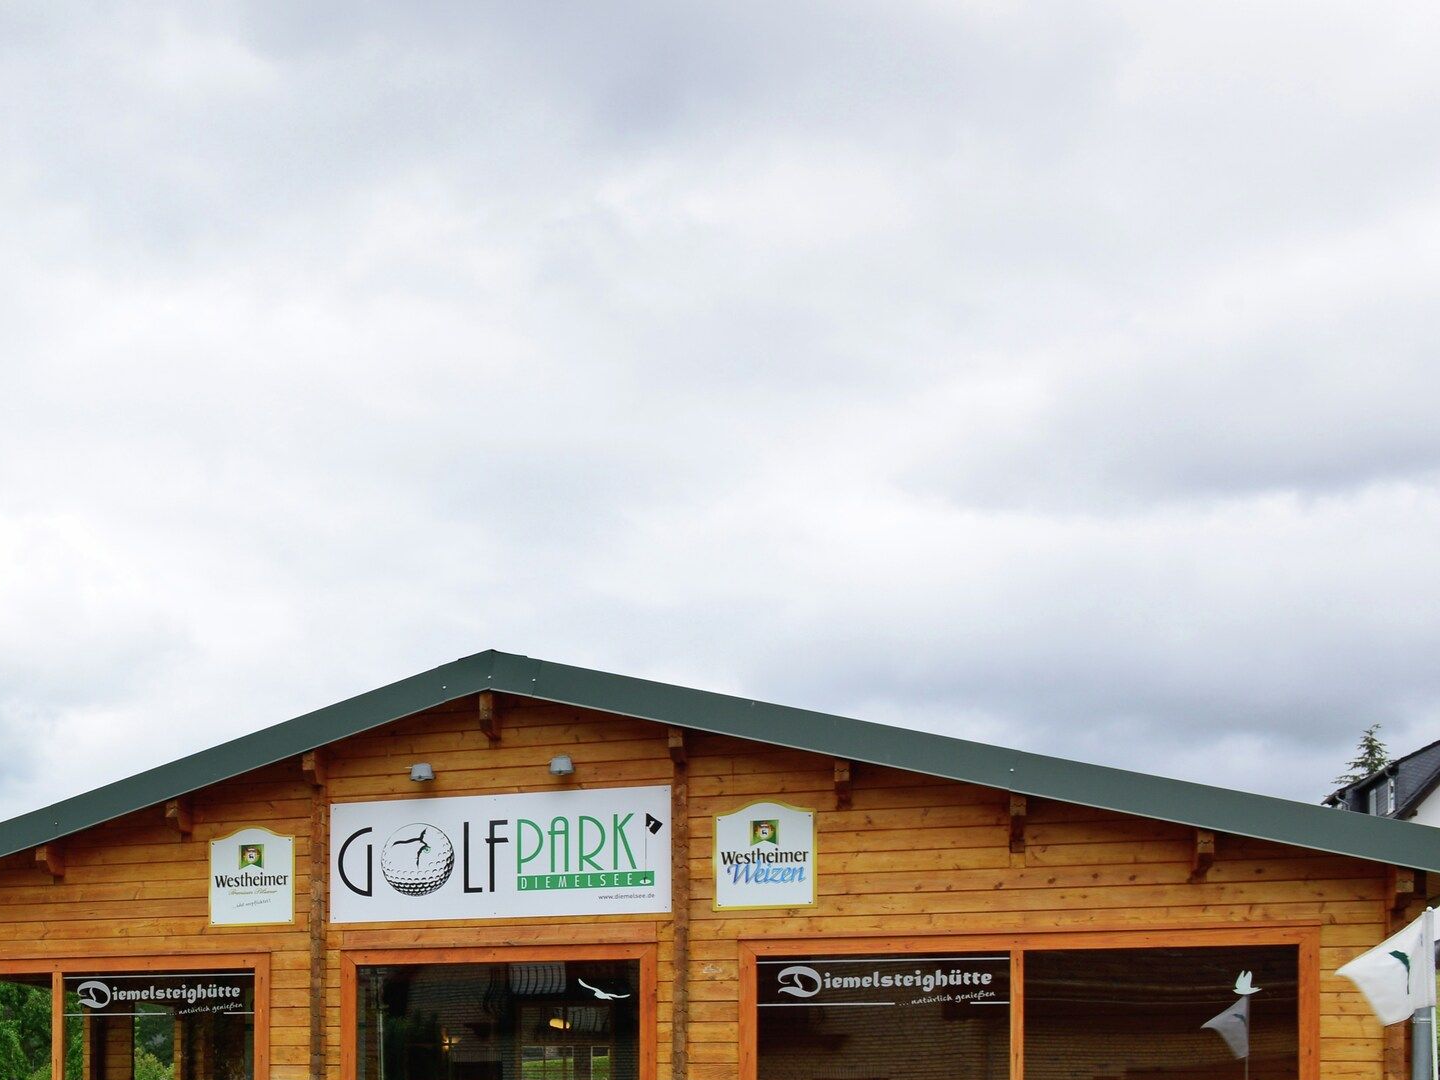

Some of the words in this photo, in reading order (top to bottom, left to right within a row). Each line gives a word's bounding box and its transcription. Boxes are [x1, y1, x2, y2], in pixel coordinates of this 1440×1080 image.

[721, 847, 809, 866] Westheimer
[215, 871, 289, 888] Westheimer
[727, 860, 805, 885] Weizen
[521, 873, 633, 890] DIEMELSEE
[598, 892, 655, 901] www.diemelsee.de
[777, 965, 993, 998] Diemelsteighütte
[77, 980, 241, 1008] Diemelsteighütte
[911, 994, 952, 1005] natürlich
[955, 989, 996, 1003] genießen
[178, 1005, 210, 1015] natürlich
[211, 1002, 243, 1013] genießen
